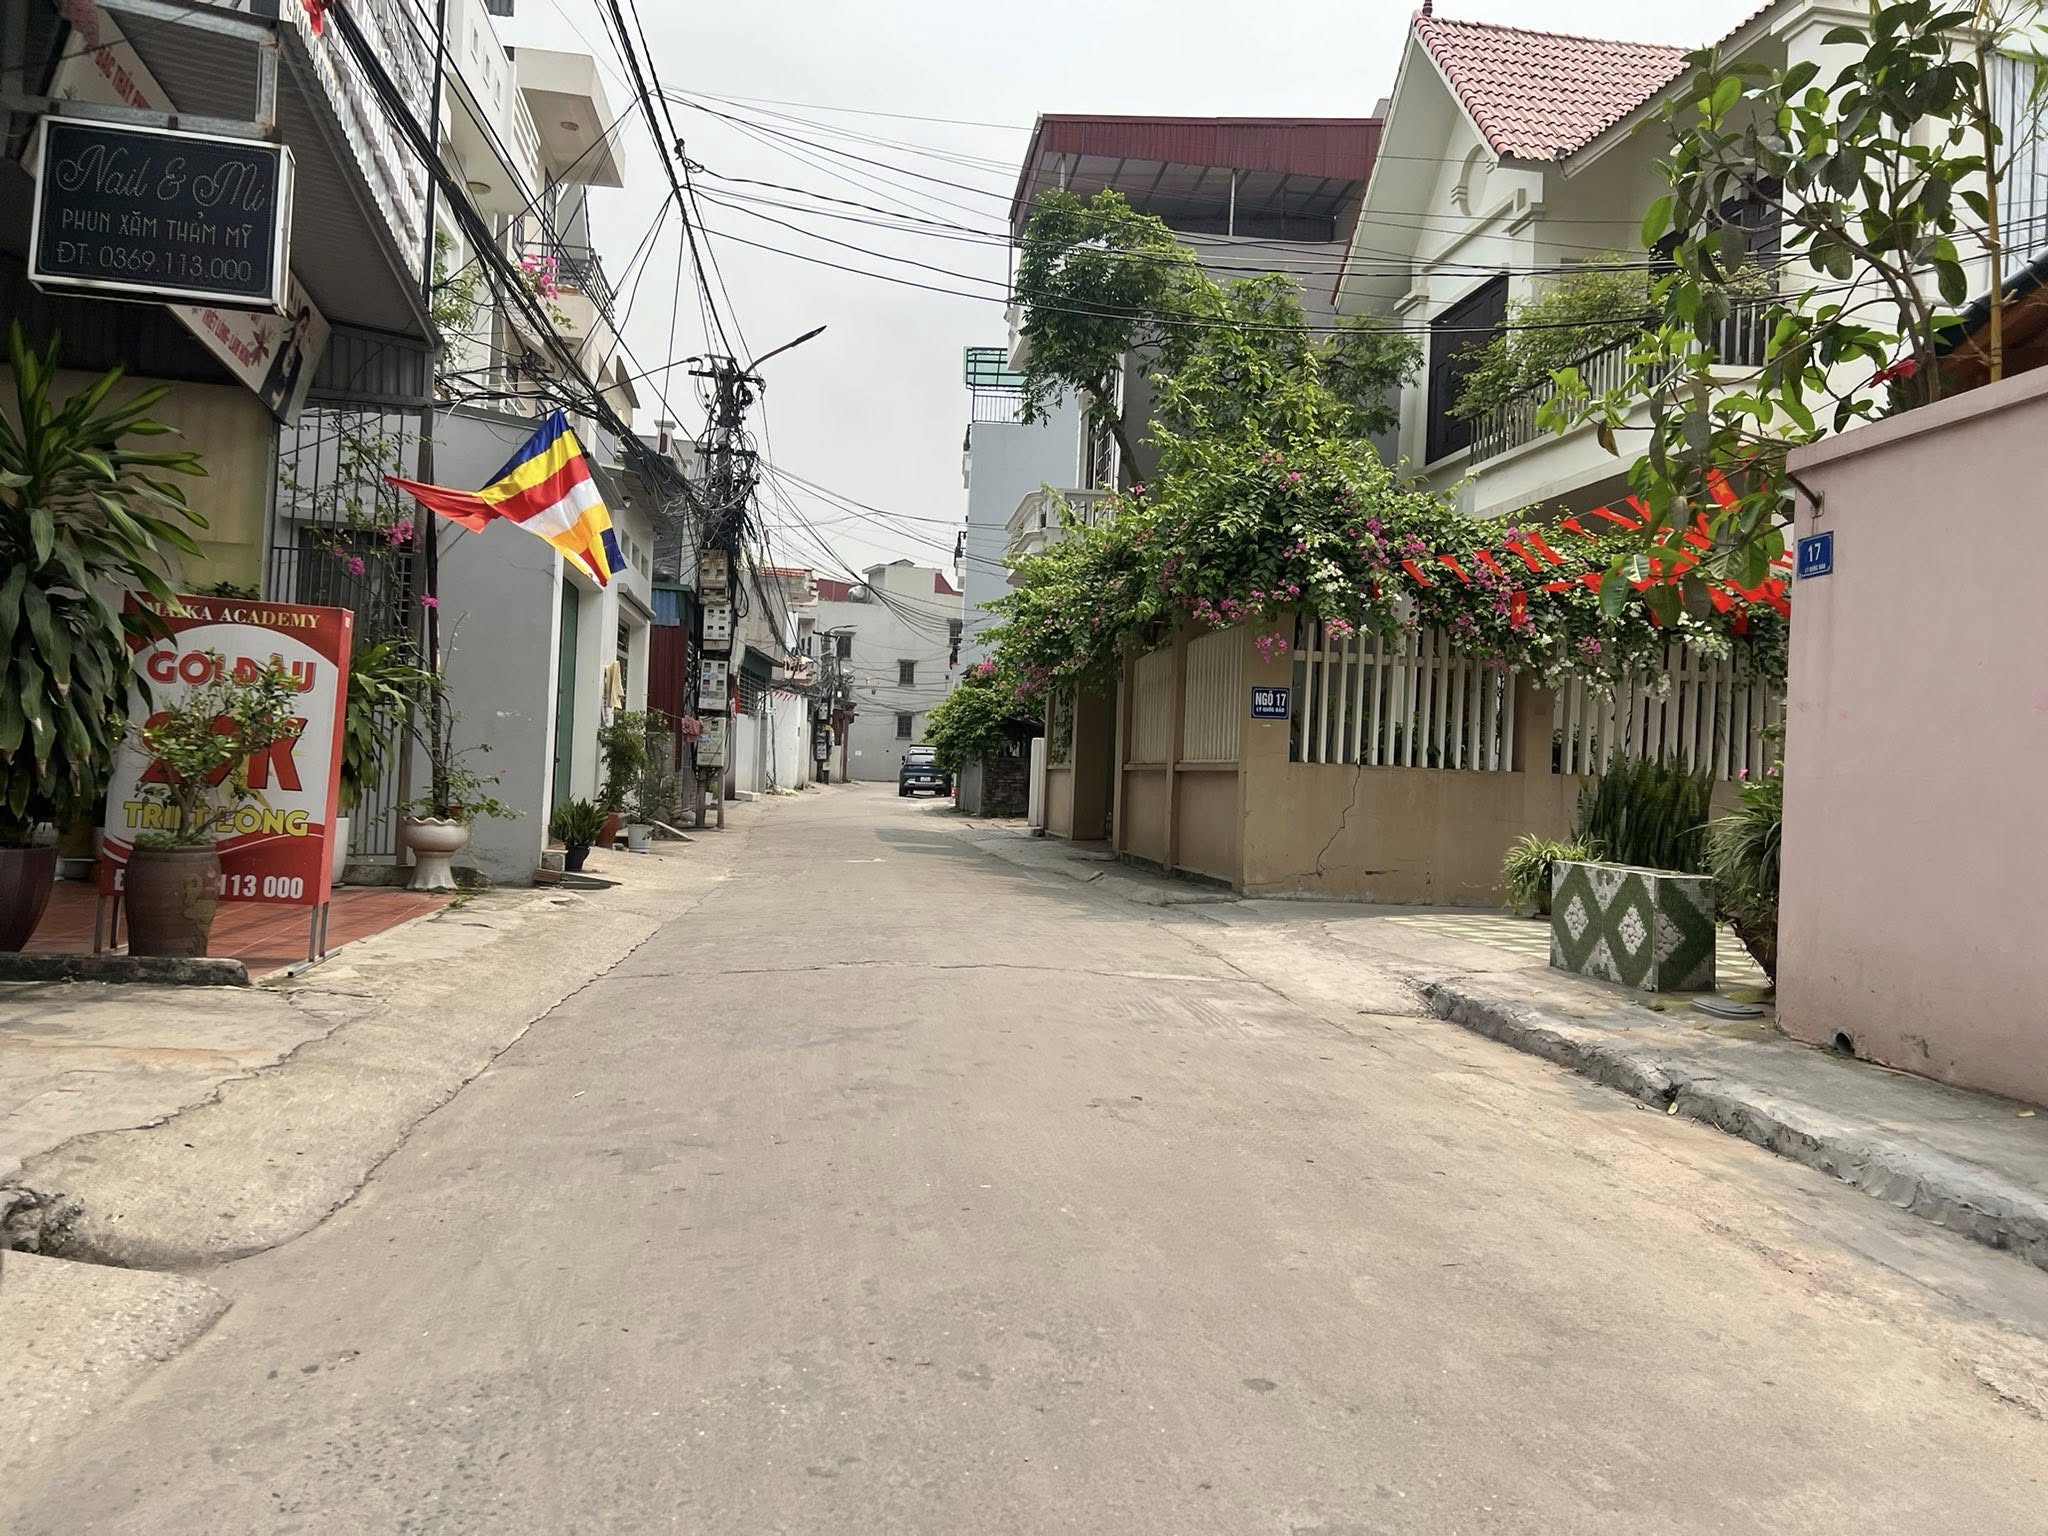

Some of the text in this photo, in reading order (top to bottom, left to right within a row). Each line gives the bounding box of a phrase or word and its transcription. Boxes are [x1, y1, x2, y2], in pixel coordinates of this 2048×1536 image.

[56, 144, 266, 212] Nail & Mi
[61, 208, 112, 233] PHUN
[118, 210, 158, 239] XĂM
[225, 223, 254, 249] MỸ
[99, 246, 252, 282] 0369.113.000
[1808, 543, 1821, 562] 17
[219, 608, 320, 629] ACADEMY
[1255, 690, 1286, 706] NGÕ 17
[263, 875, 304, 899] 000
